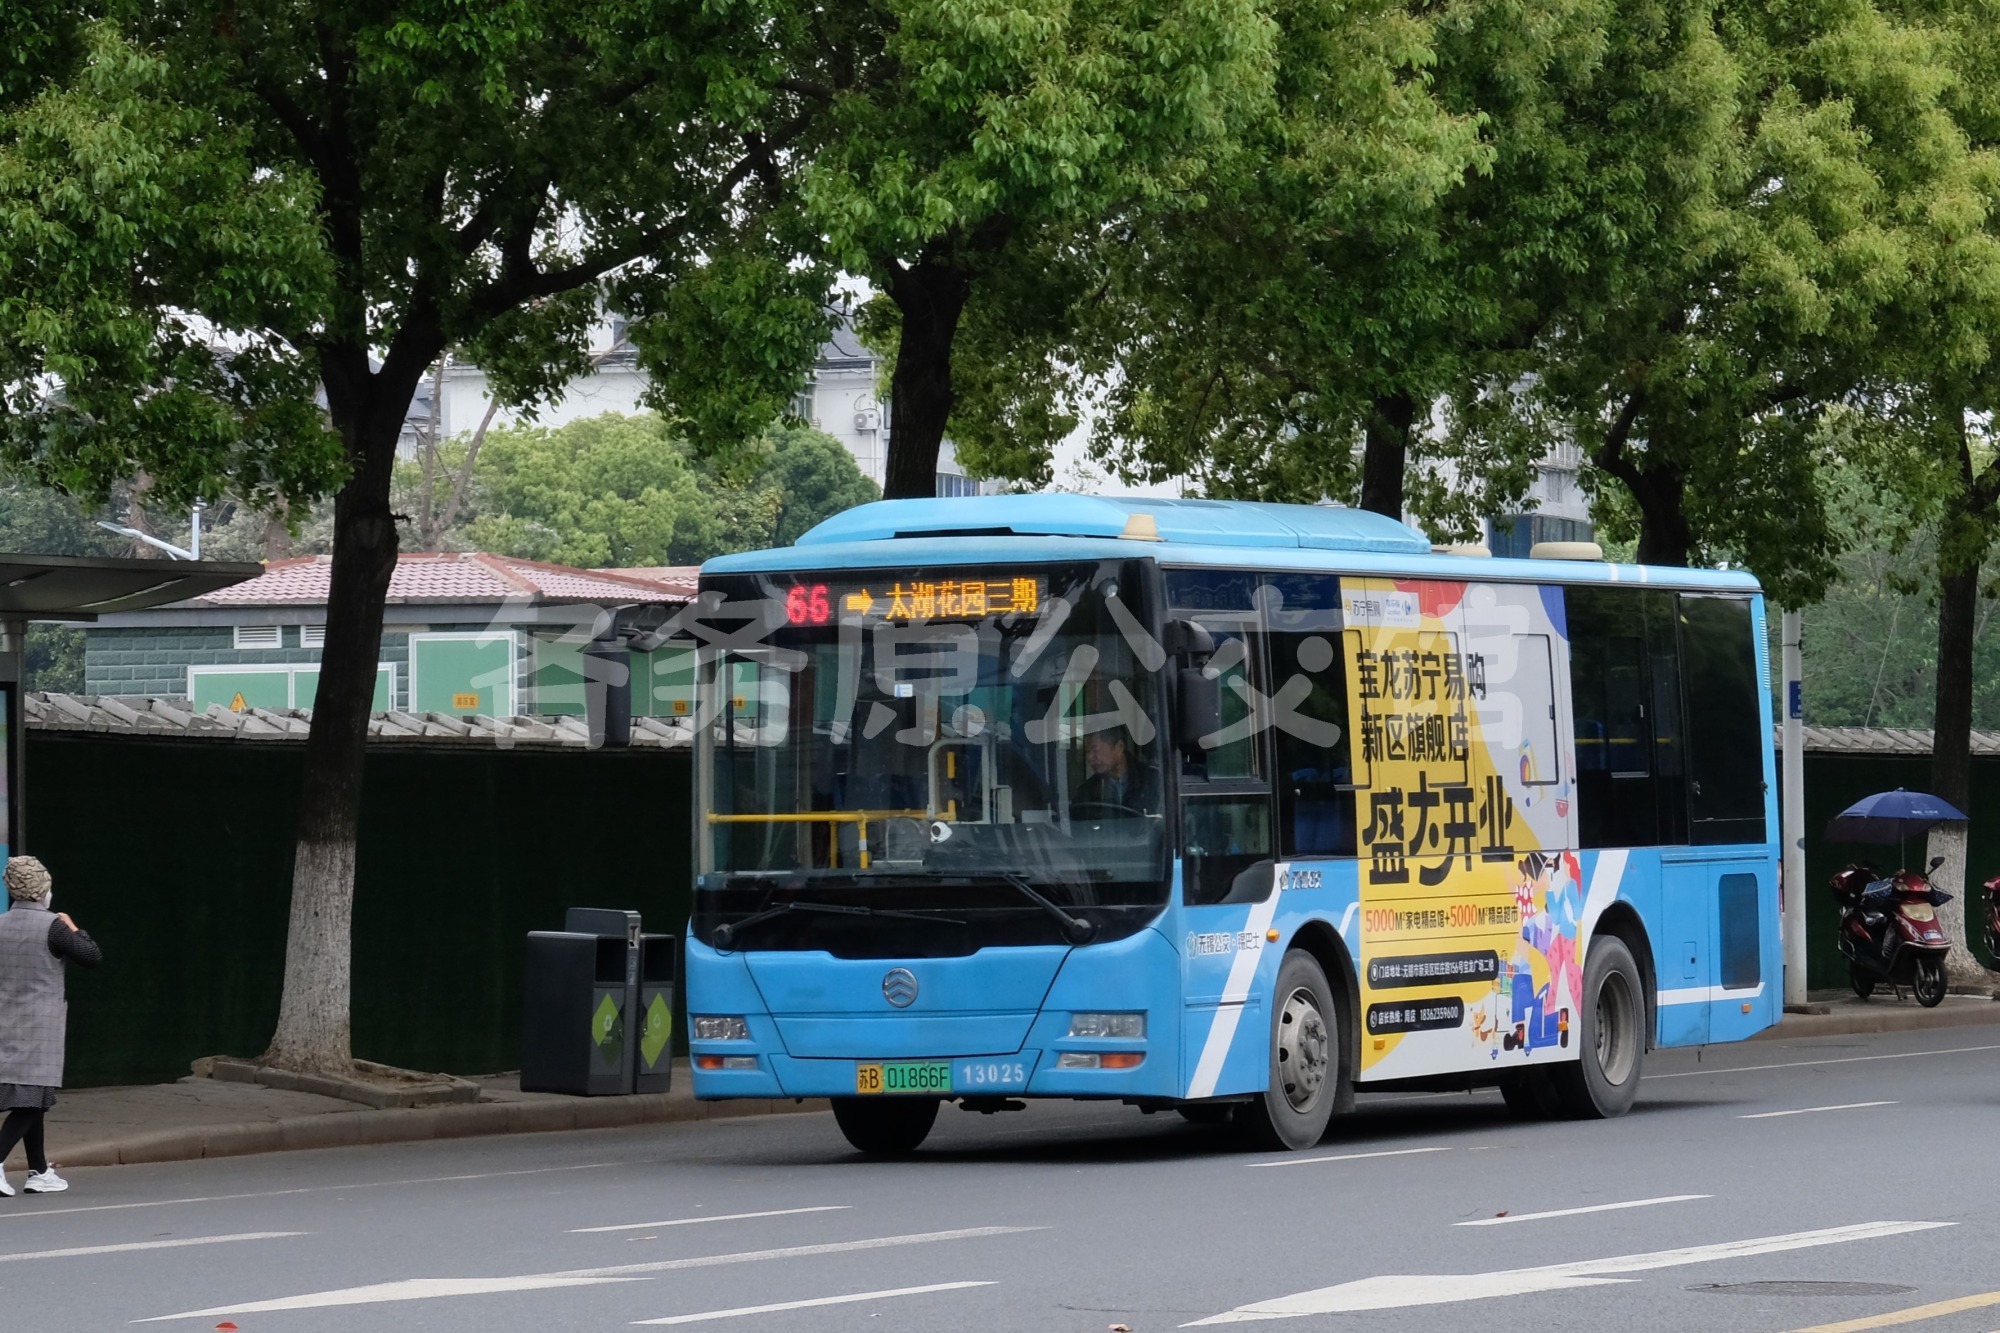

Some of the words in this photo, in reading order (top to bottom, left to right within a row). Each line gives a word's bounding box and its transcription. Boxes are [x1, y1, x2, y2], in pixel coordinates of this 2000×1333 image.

[786, 584, 830, 625] 66
[886, 577, 1038, 619] 太湖花园三期
[1356, 649, 1487, 700] 宝龙苏宁易购
[1360, 704, 1469, 763] 新区旗舰店
[1362, 770, 1515, 886] 盛大开业
[963, 1062, 1025, 1085] 13025
